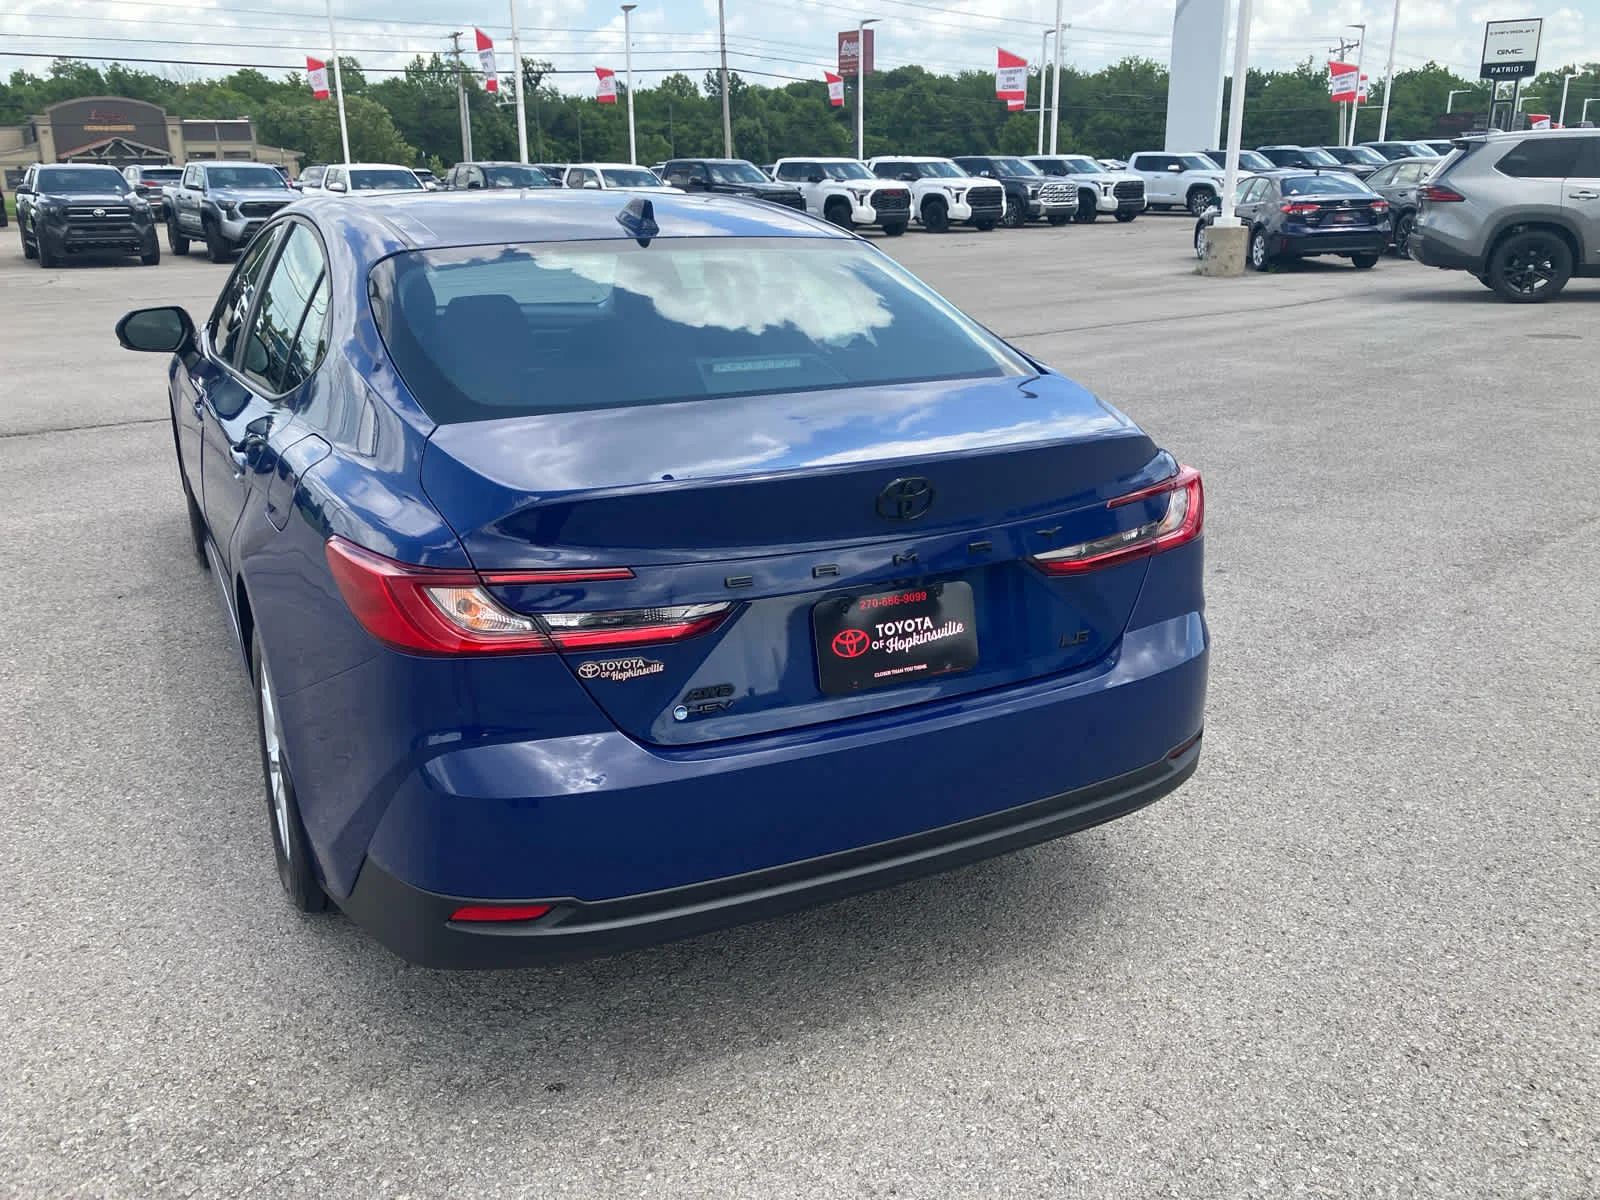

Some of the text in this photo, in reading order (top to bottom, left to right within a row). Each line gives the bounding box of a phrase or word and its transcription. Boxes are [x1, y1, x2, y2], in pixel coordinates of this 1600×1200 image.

[1496, 48, 1525, 56] GMC
[1491, 65, 1525, 74] PATRIOT
[875, 616, 934, 637] TOYOTA
[871, 621, 965, 654] OF Hopkinsville
[1060, 630, 1090, 649] LE
[600, 660, 645, 672] TOYOTA
[600, 663, 665, 682] OF Hopkinsville
[904, 665, 914, 673] YOU
